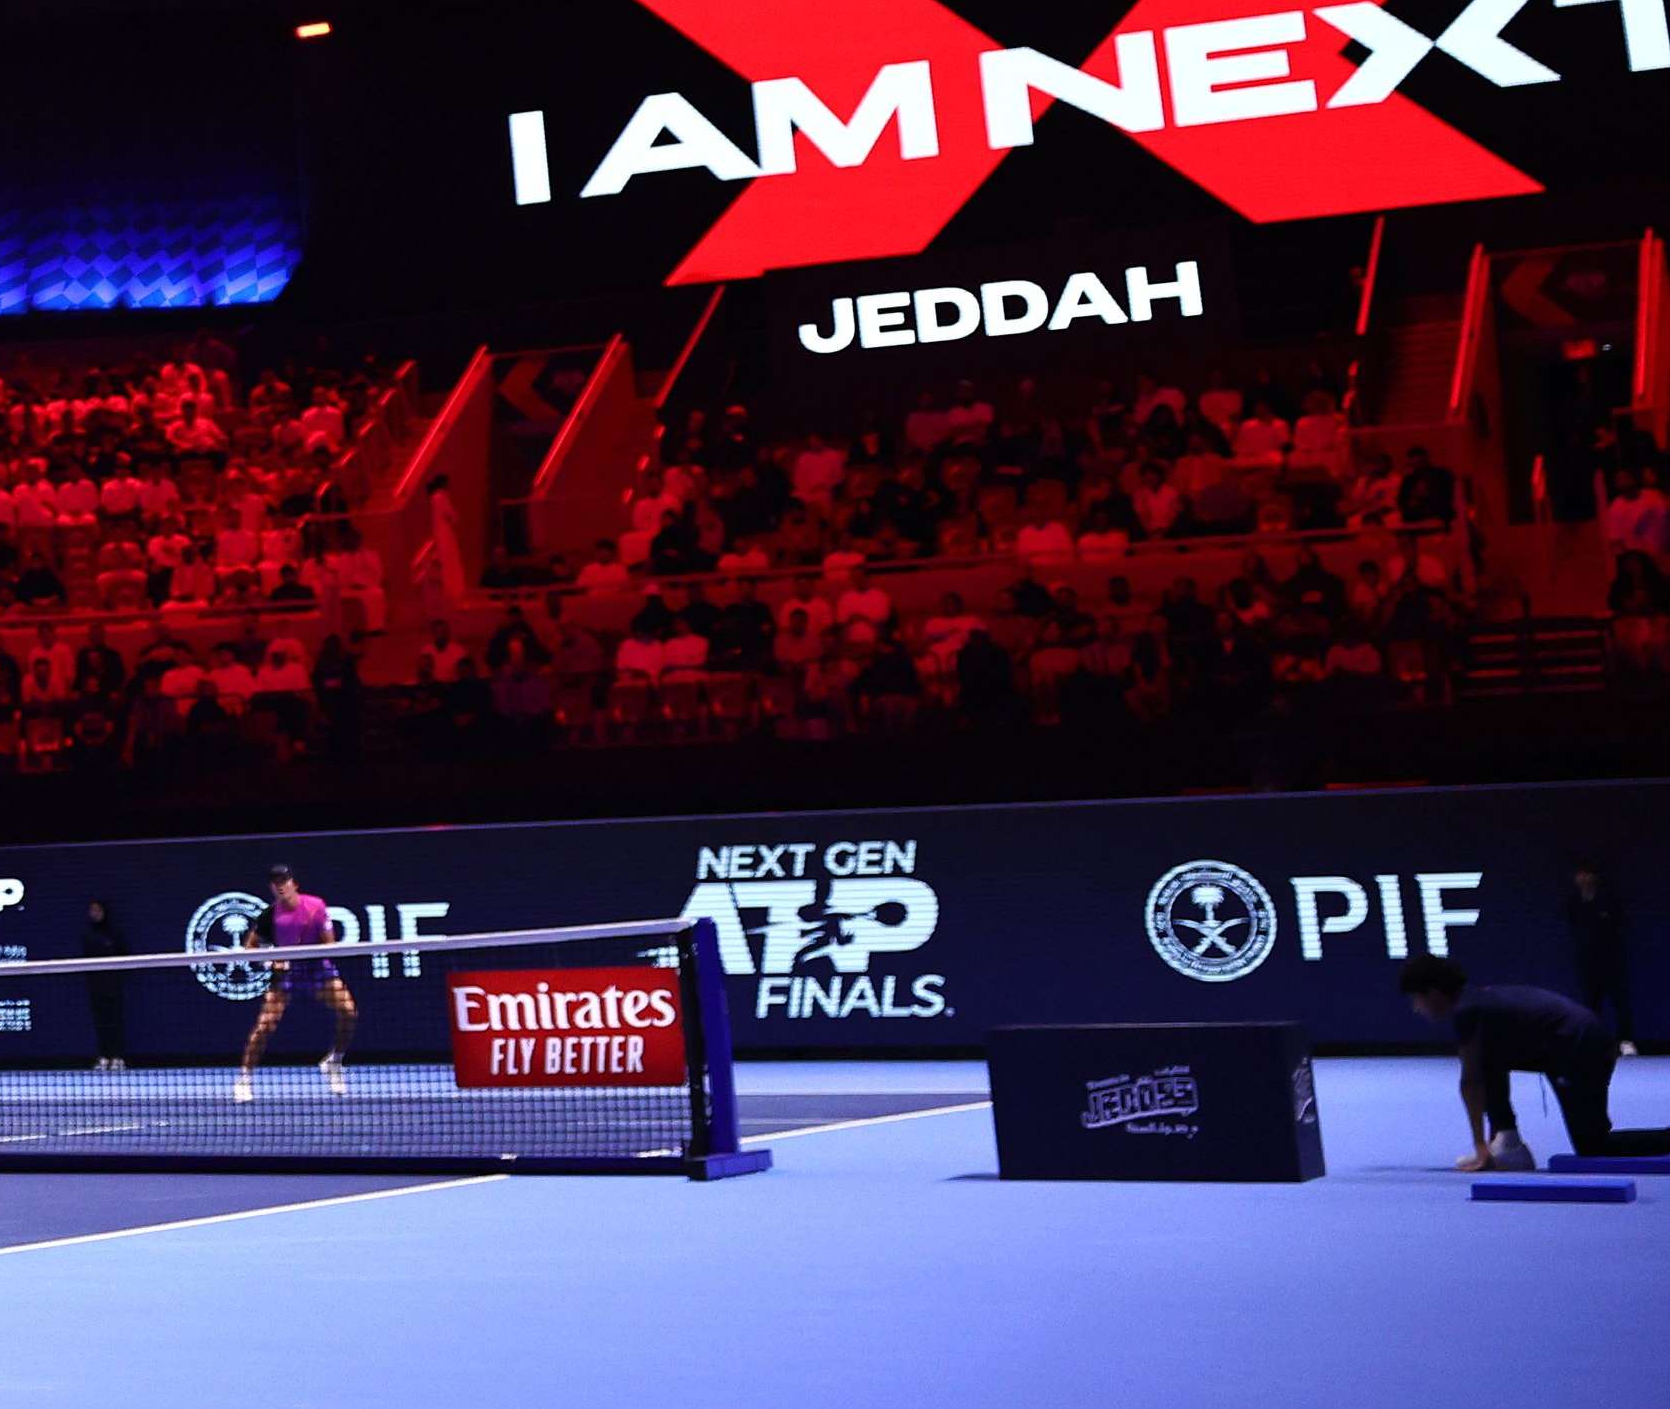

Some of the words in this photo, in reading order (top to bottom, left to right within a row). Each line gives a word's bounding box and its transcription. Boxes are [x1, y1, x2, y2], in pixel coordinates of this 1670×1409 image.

[508, 109, 552, 205] I
[580, 59, 940, 197] AM
[798, 261, 1204, 355] JEDDAH
[696, 843, 815, 880] NEXT
[824, 840, 917, 876] GEN
[637, 877, 939, 975] ATP
[1290, 871, 1484, 960] PIF
[451, 982, 677, 1032] Emirates
[755, 974, 946, 1019] FINALS
[490, 1037, 536, 1076] FLY
[544, 1035, 645, 1075] BETTER
